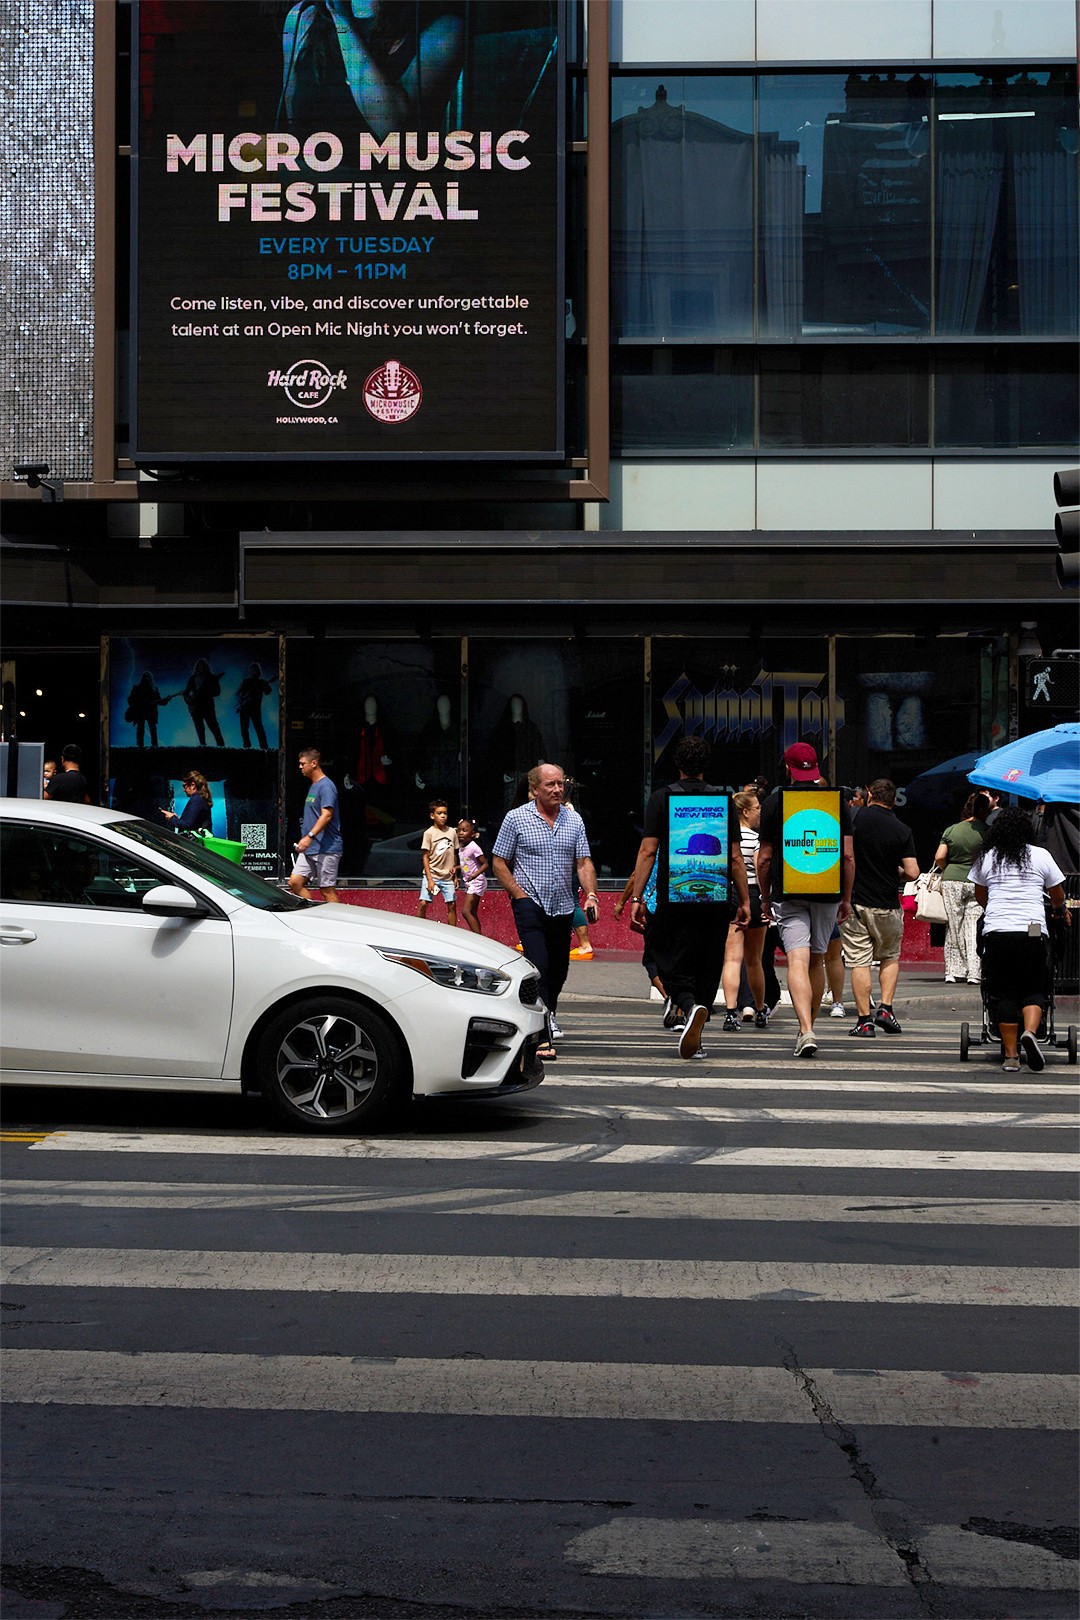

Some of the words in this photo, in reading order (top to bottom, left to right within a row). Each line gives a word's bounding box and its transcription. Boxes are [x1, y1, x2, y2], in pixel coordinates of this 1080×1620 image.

[166, 132, 344, 172] MICRO
[359, 130, 531, 170] MUSIC
[218, 182, 479, 222] FESTIVAL
[259, 238, 329, 254] EVERY
[335, 237, 435, 254] TUESDAY
[287, 263, 332, 280] 8PM
[354, 263, 406, 279] 11PM
[170, 297, 217, 311] Come
[221, 297, 268, 312] listen,
[271, 296, 309, 312] vibe,
[313, 296, 343, 310] and
[348, 296, 415, 310] discover
[418, 295, 530, 312] unforgettable
[171, 322, 219, 337] talent
[223, 324, 240, 337] at
[244, 325, 264, 337] an
[268, 322, 312, 338] Open
[316, 322, 342, 336] Mic
[347, 322, 390, 339] Night
[393, 325, 424, 339] you
[426, 322, 471, 337] won't
[474, 321, 528, 338] forget.
[267, 369, 309, 387] Hard
[309, 369, 348, 390] Rock
[298, 391, 319, 399] CAFE
[275, 416, 327, 425] HOLLYWOOD,
[328, 416, 339, 424] CA
